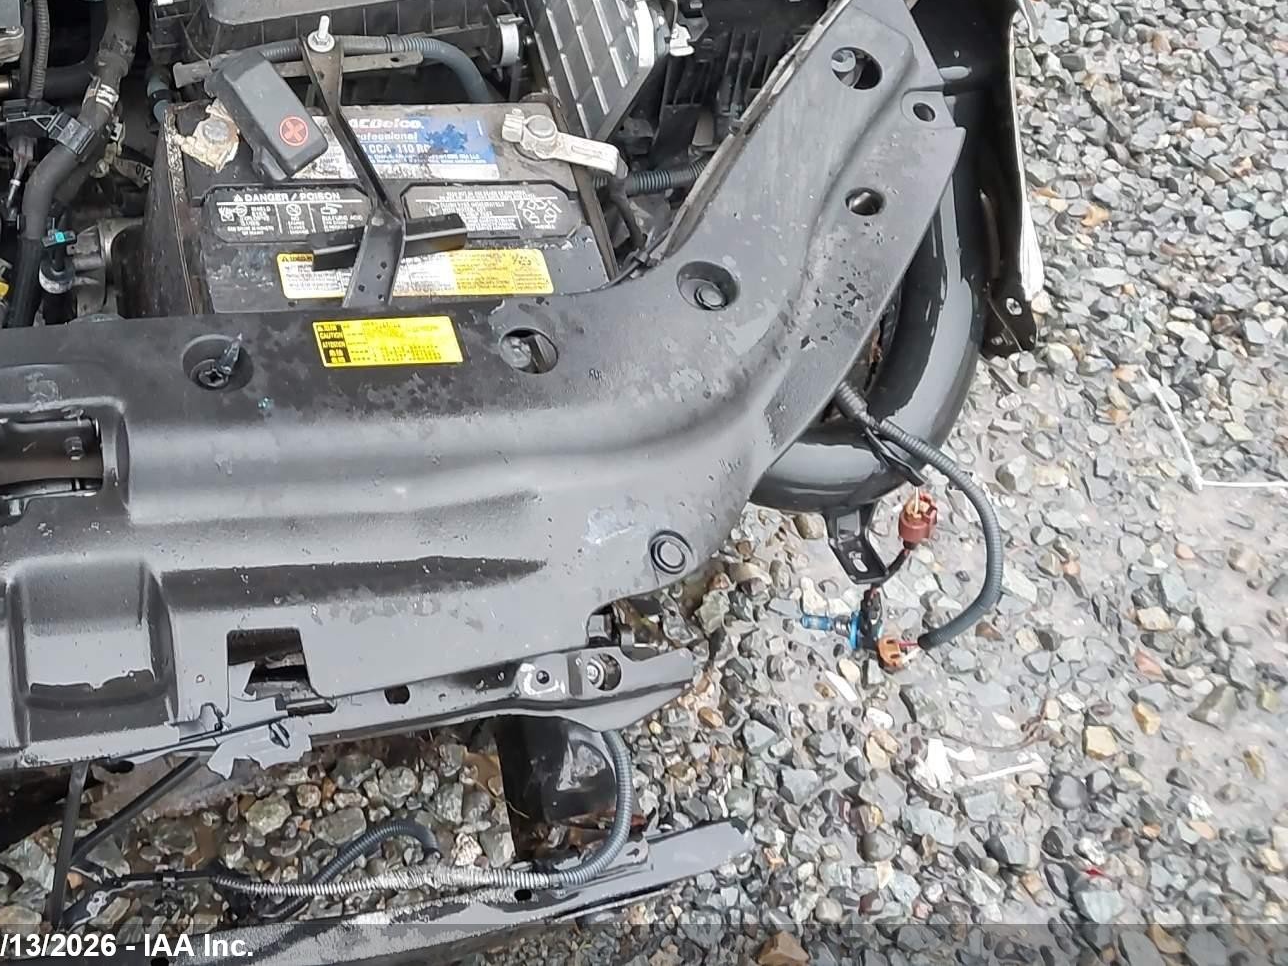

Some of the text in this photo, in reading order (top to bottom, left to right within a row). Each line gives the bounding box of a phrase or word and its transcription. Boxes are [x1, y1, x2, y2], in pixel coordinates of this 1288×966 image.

[368, 144, 391, 154] CCA
[244, 192, 289, 202] DANGER
[300, 191, 341, 201] POISON
